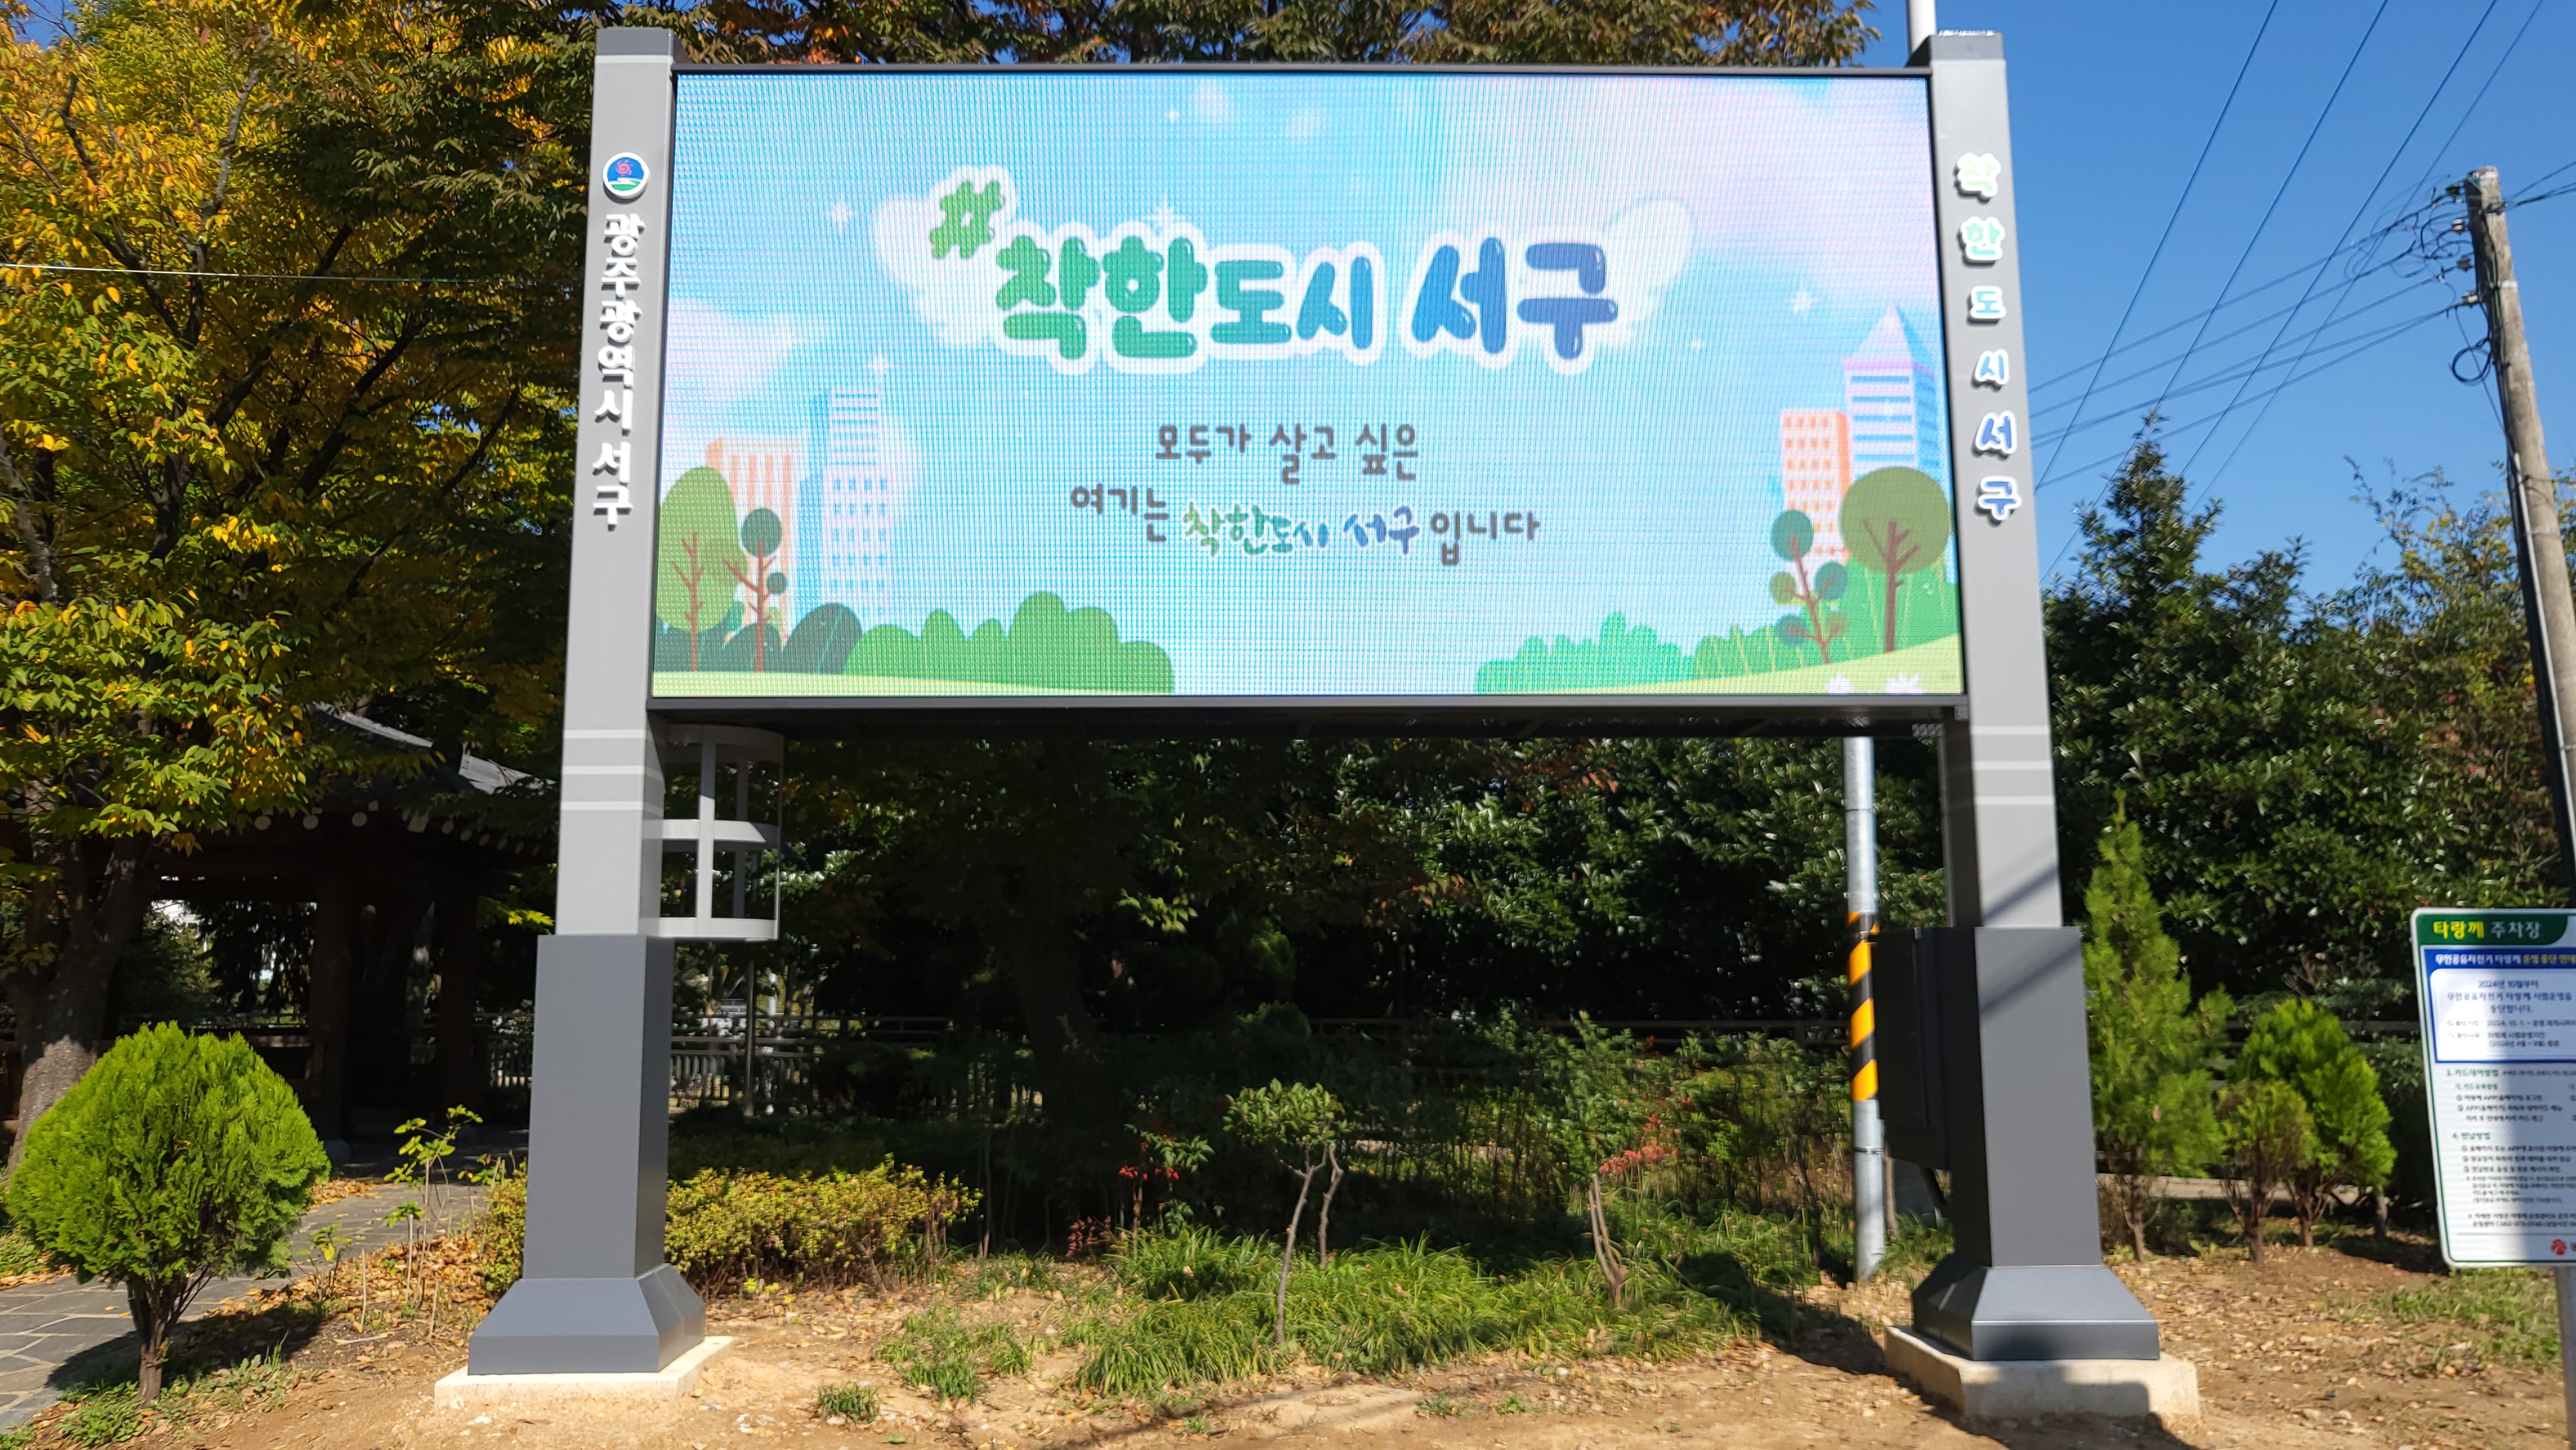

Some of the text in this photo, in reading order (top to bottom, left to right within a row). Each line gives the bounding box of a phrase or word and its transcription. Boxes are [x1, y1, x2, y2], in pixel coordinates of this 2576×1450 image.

[1411, 236, 1619, 360] 서구
[592, 214, 645, 527] 광주광역시 서구
[1155, 423, 1419, 484] 모두가 살고 싶은
[1070, 483, 1170, 543] 여기는
[1182, 501, 1330, 556] 착한도시
[2433, 921, 2541, 939] 타랑께 주차장
